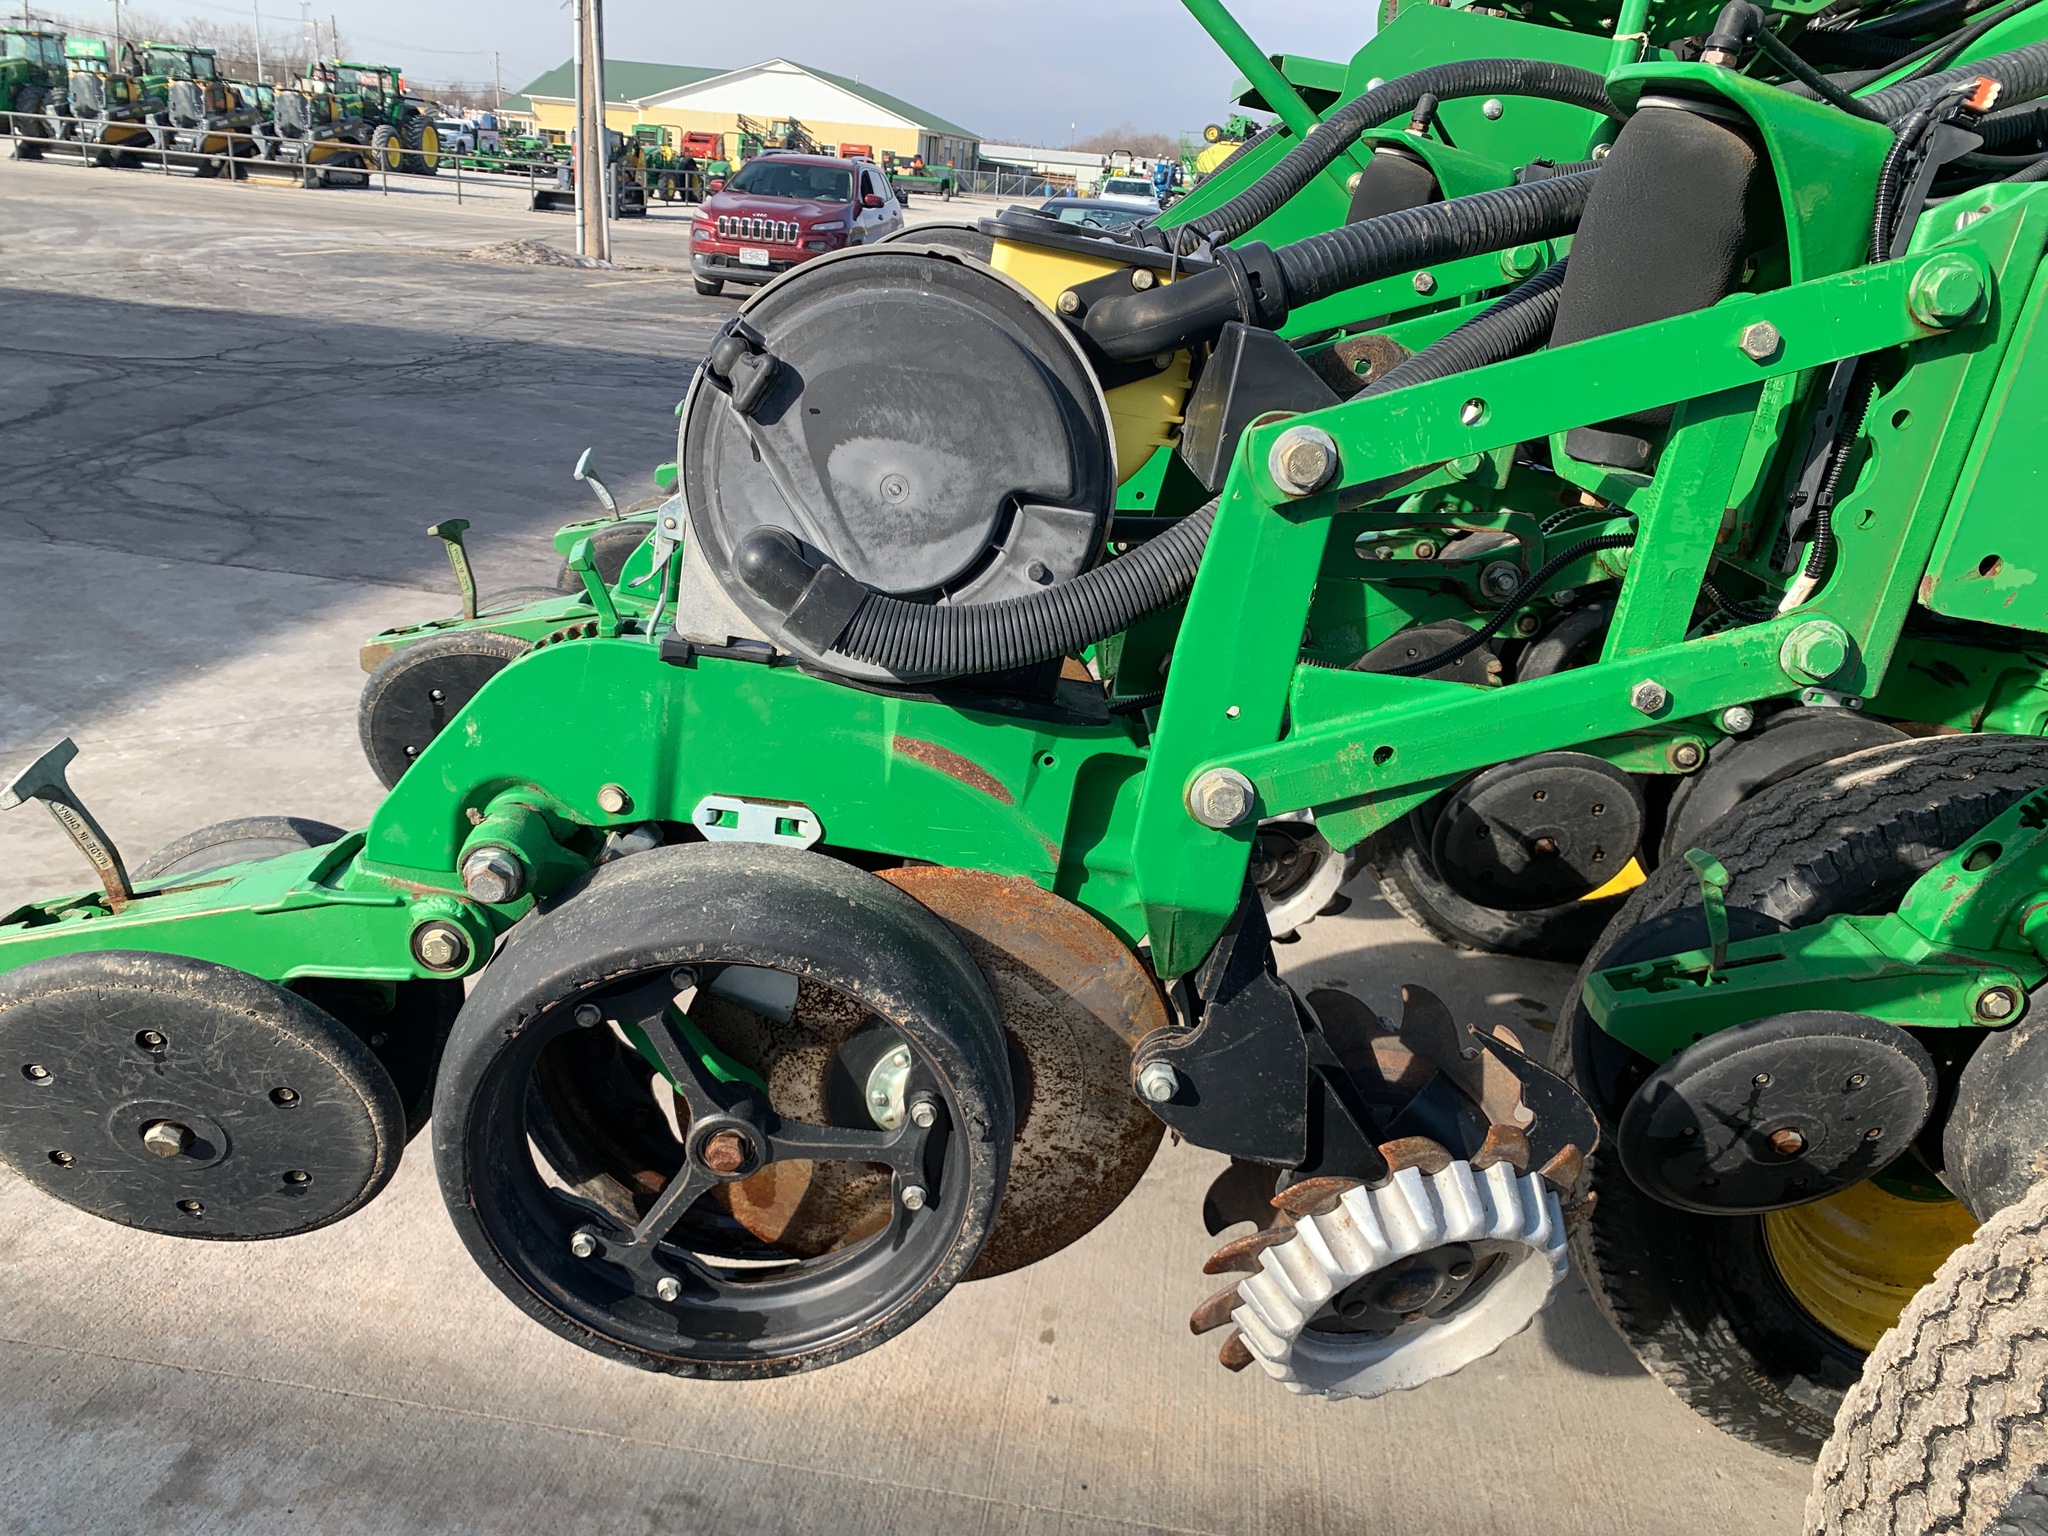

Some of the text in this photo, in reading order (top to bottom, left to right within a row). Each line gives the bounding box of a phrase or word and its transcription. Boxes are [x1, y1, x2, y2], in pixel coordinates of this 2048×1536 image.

[57, 804, 108, 865] MADE IN CHINA
